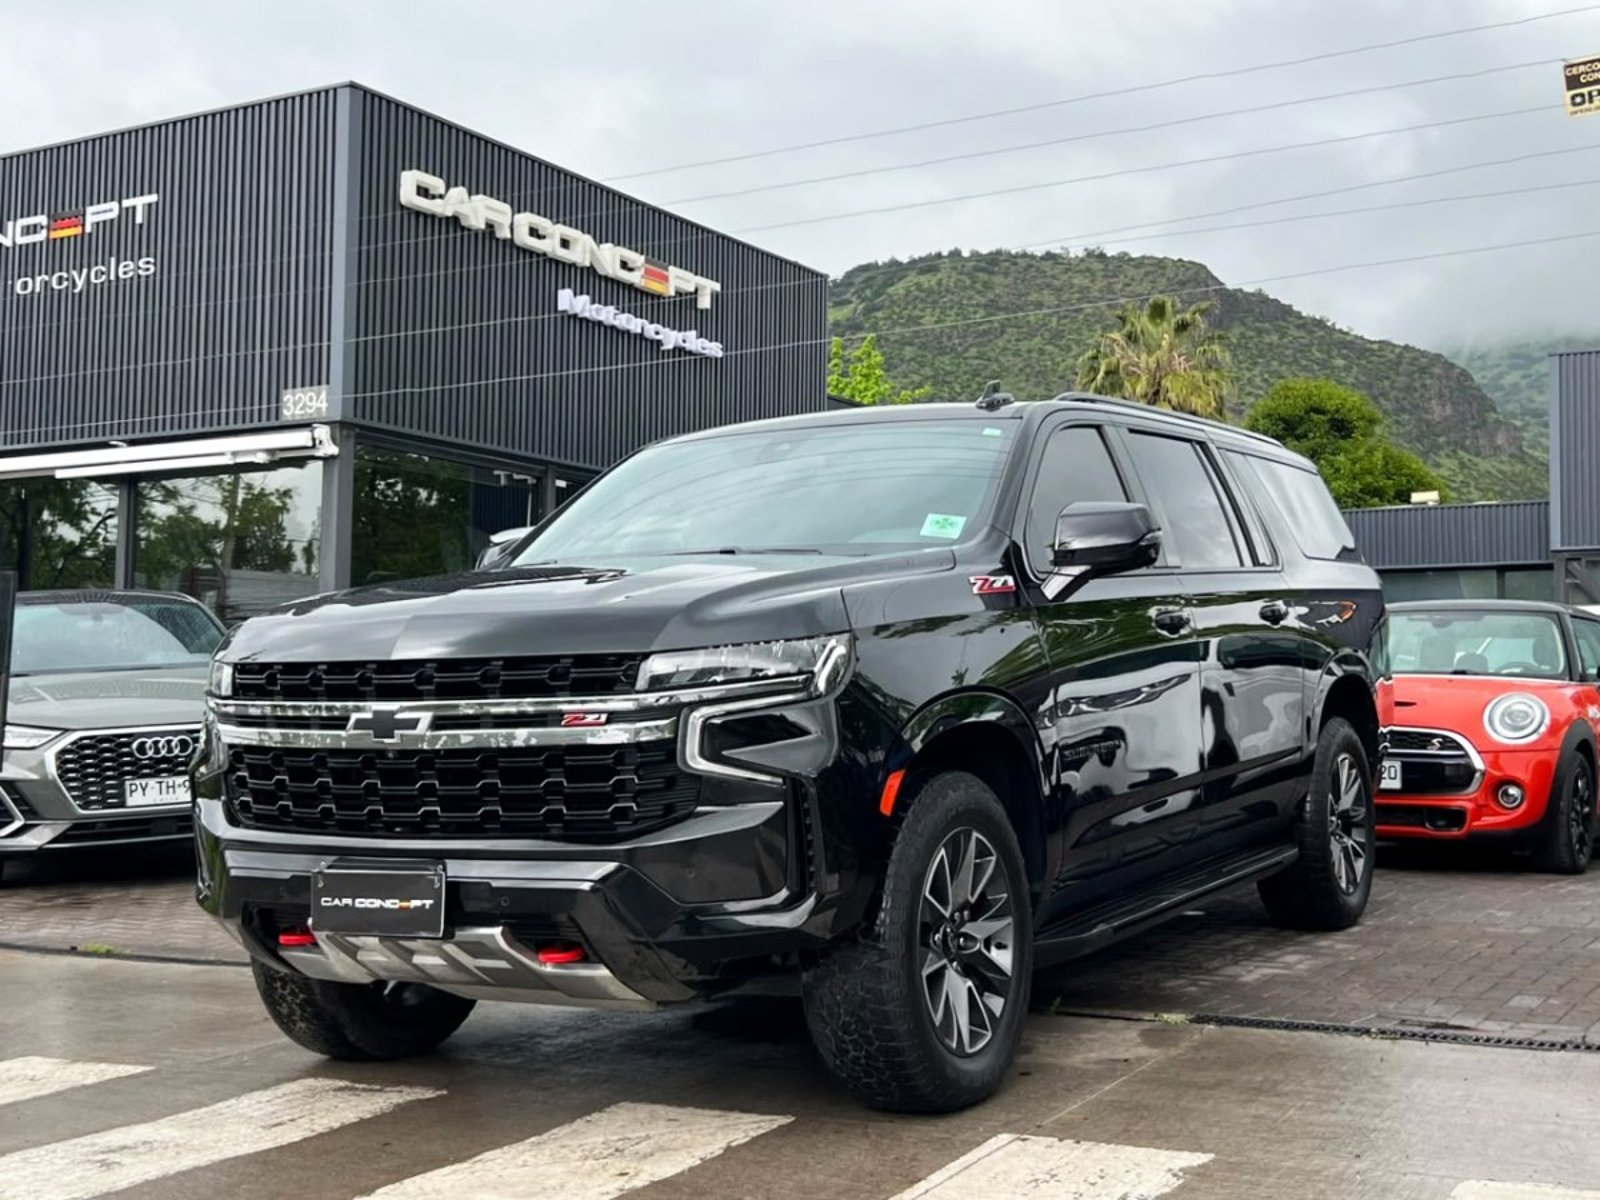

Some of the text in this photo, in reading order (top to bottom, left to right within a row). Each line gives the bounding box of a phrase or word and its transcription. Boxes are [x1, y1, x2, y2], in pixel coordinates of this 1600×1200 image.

[400, 169, 512, 239] CAR
[282, 389, 329, 417] 3294
[320, 896, 353, 907] CAR
